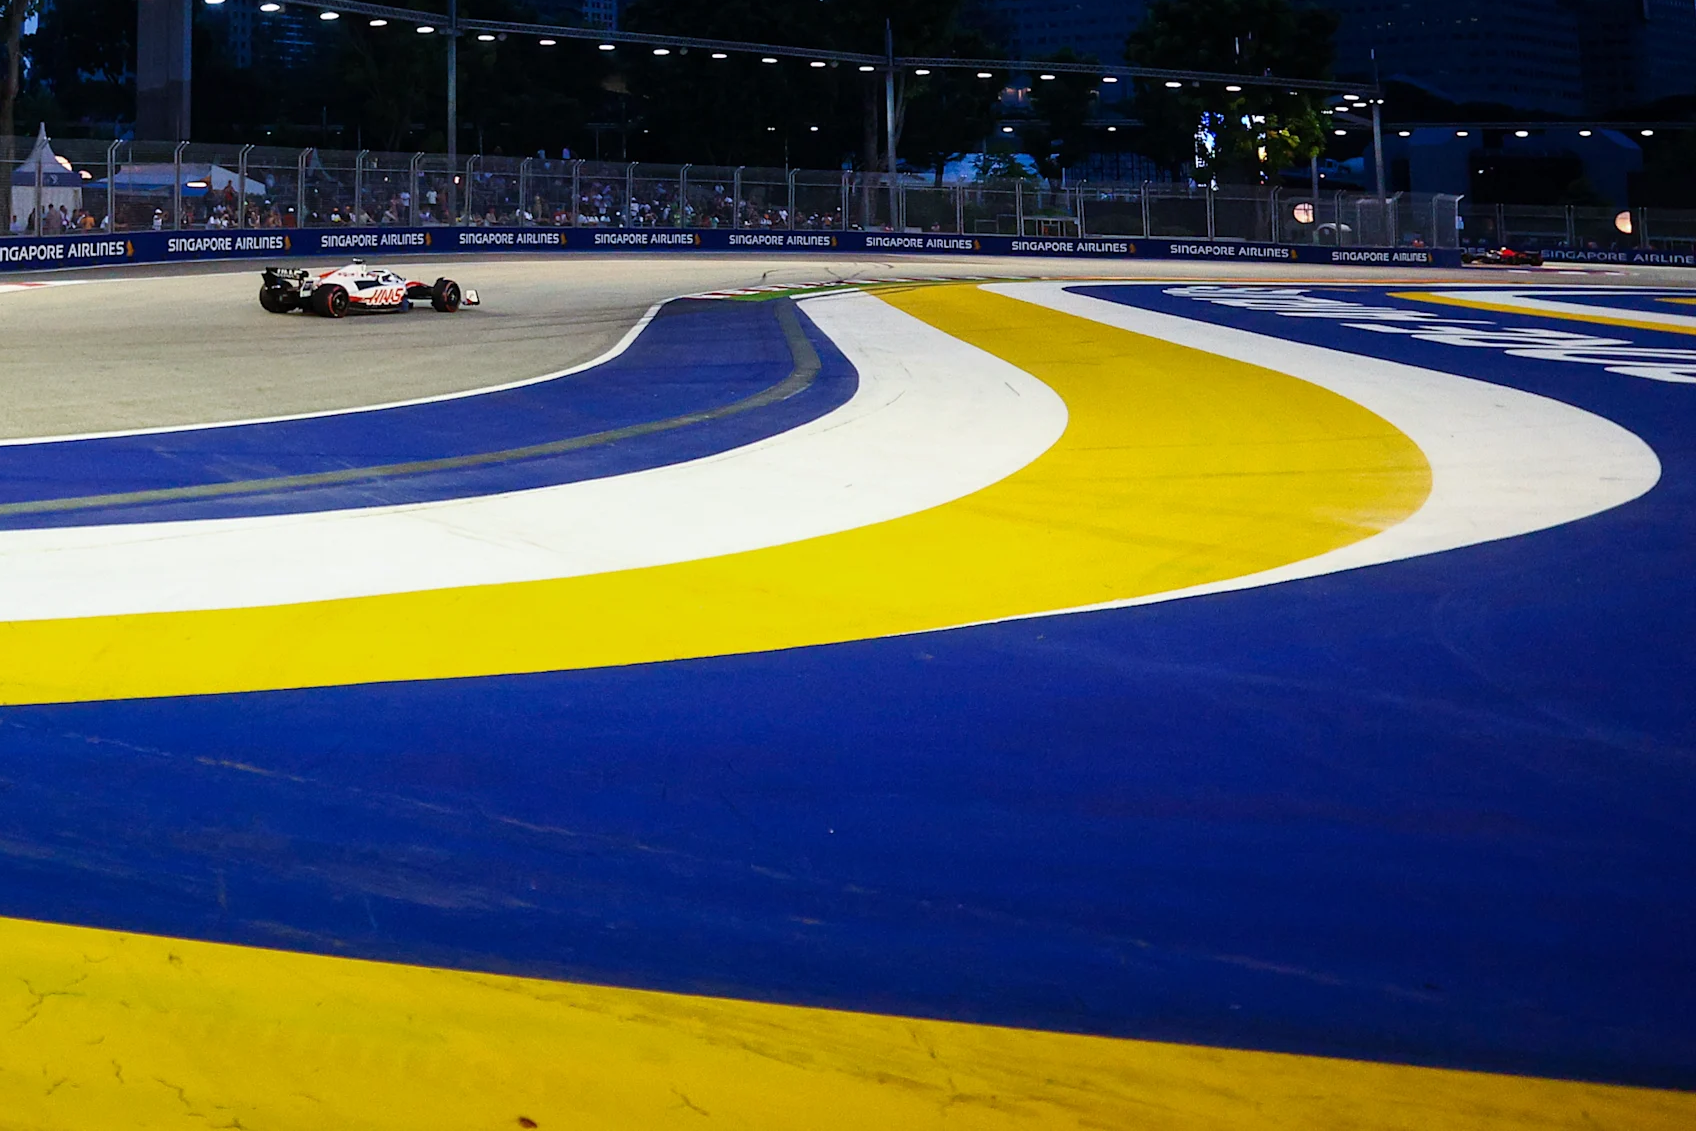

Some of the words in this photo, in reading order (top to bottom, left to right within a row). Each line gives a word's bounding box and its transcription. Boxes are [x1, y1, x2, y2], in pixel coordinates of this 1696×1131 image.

[168, 237, 232, 252] SINGAPORE
[234, 236, 283, 250] AIRLINES
[321, 234, 378, 248] SINGAPORE
[380, 233, 424, 246] AIRLINES
[459, 233, 514, 245] SINGAPORE
[516, 233, 560, 244] AIRLINES
[594, 233, 648, 245] SINGAPORE
[650, 233, 694, 244] AIRLINES
[729, 234, 784, 246] SINGAPORE
[786, 235, 830, 246] AIRLINES
[866, 236, 924, 248] SINGAPORE
[926, 238, 973, 249] AIRLINES
[67, 241, 125, 258] AIRLINES
[1011, 241, 1074, 252] SINGAPORE
[1076, 242, 1128, 253] AIRLINES
[1170, 244, 1235, 256] SINGAPORE
[1238, 246, 1289, 258] AIRLINES
[1332, 251, 1389, 262] SINGAPORE
[1392, 252, 1427, 262] AIRLINES
[1540, 249, 1627, 261] SINGAPORE
[368, 287, 404, 304] HAAS
